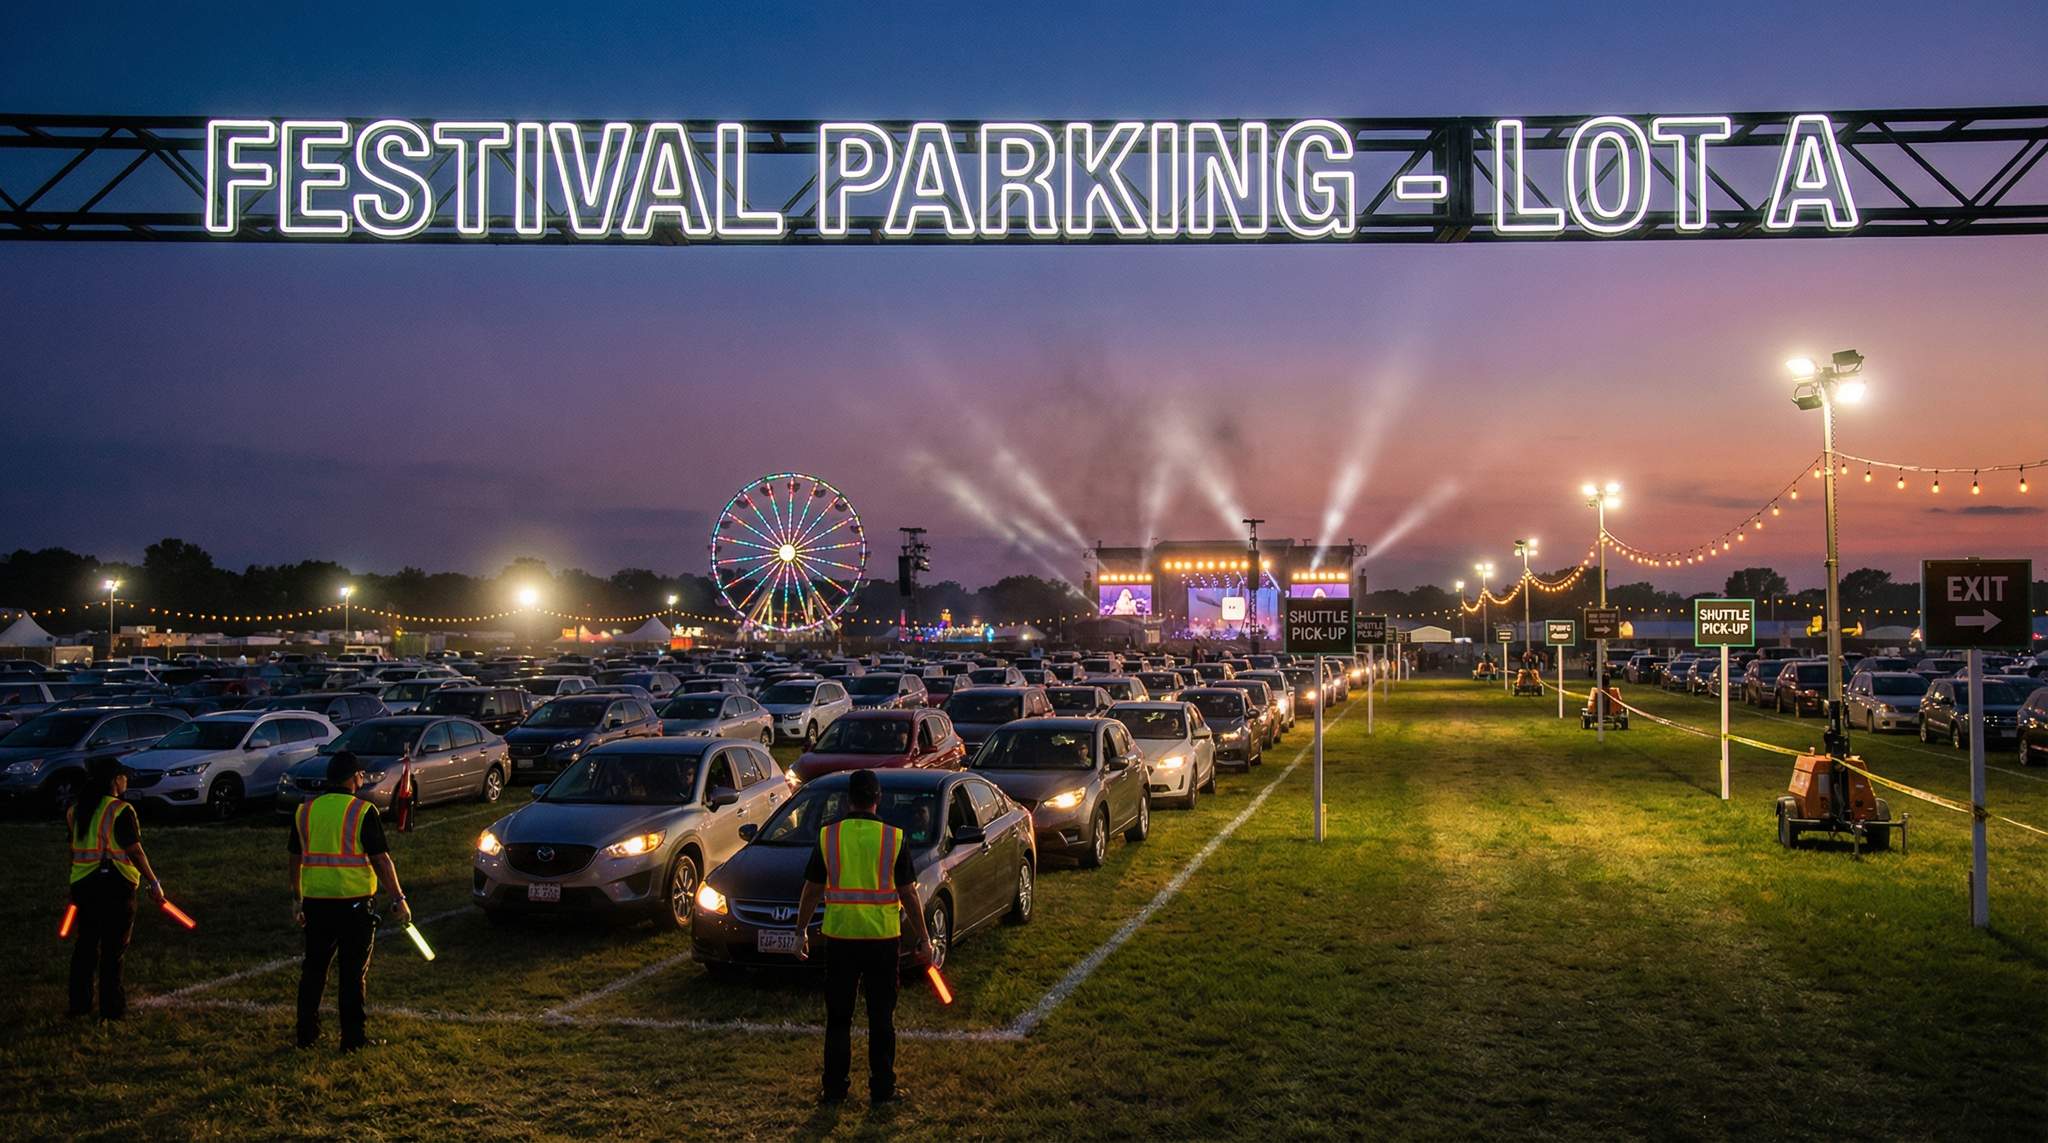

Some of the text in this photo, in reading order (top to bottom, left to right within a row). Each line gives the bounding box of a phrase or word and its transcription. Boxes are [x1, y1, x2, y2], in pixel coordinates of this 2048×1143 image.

[204, 113, 1860, 238] FESTIVAL PARKING - LOT A
[1947, 576, 2008, 602] EXIT
[1290, 610, 1349, 623] SHUTTLE
[1699, 609, 1750, 621] SHUTTLE
[1292, 627, 1347, 640] PICK-UP
[1701, 623, 1748, 635] PICK-UP
